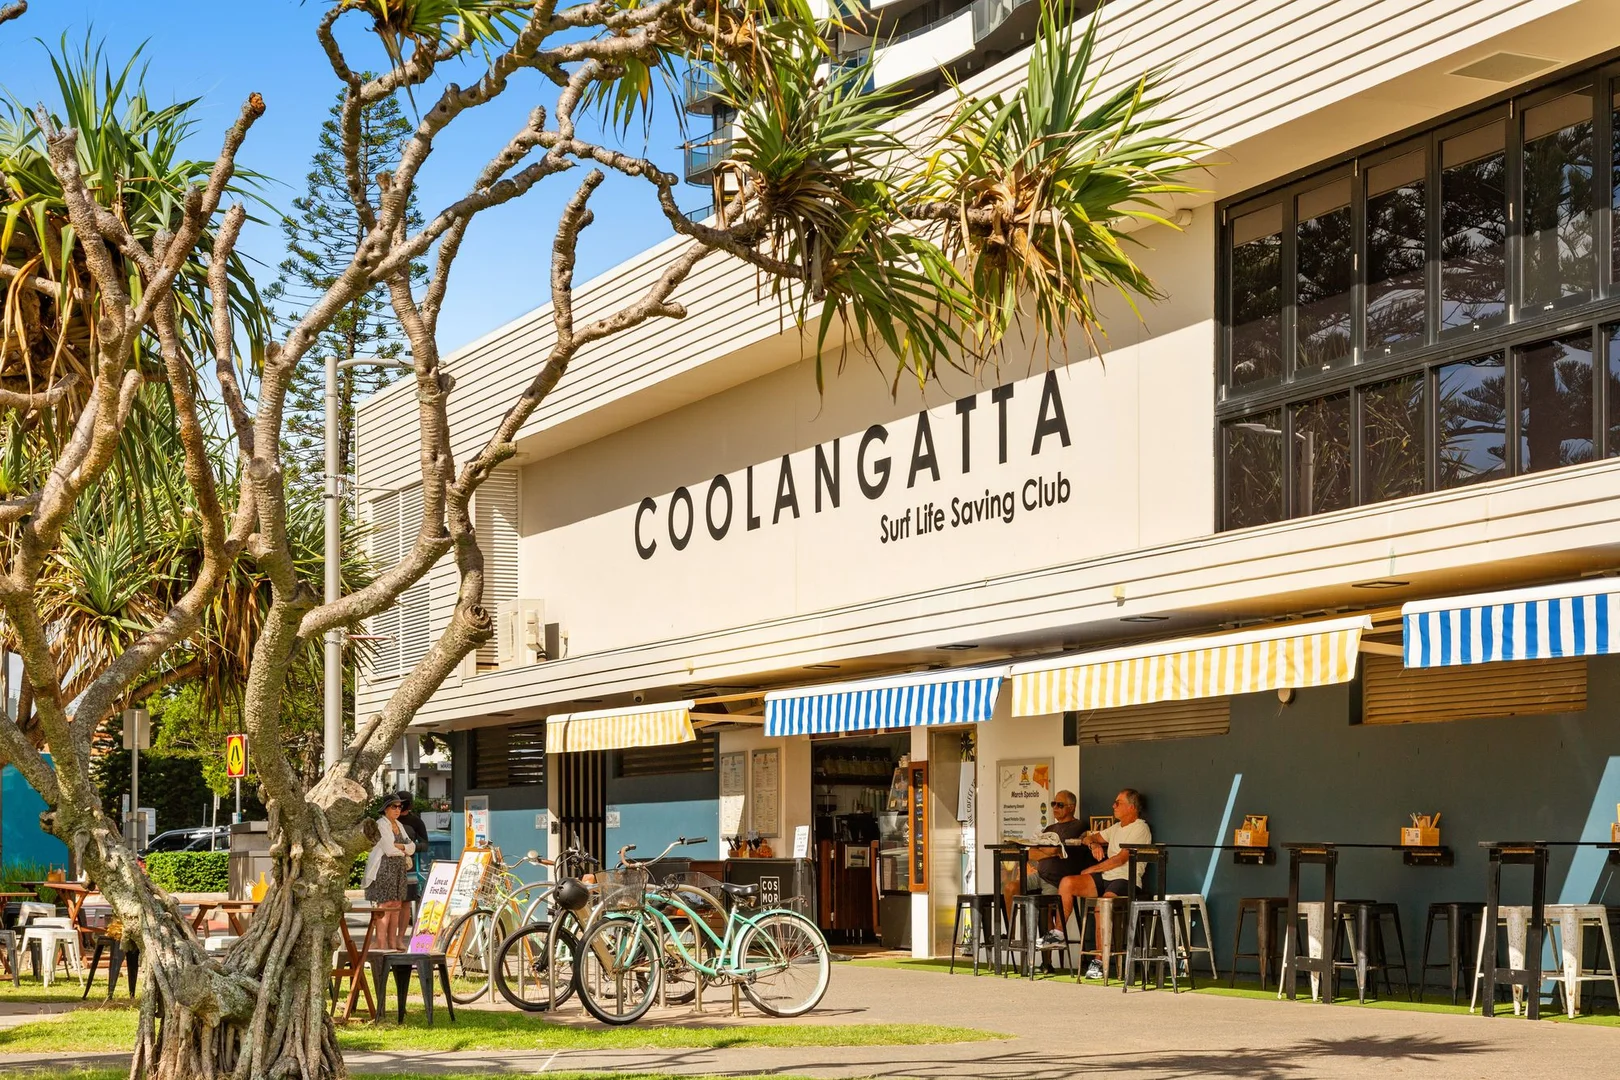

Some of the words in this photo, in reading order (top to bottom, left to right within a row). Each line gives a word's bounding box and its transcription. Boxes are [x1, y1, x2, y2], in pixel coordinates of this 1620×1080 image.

[634, 370, 1071, 560] COOLANGATTA
[880, 508, 912, 543] Surf
[916, 503, 945, 536] Life
[950, 489, 1015, 528] Saving
[1022, 471, 1071, 511] Club
[1011, 790, 1023, 798] March
[1023, 790, 1039, 799] Specials
[966, 787, 974, 813] COFFEE
[433, 877, 443, 885] Love
[762, 880, 778, 891] COS
[429, 886, 440, 894] First
[439, 886, 448, 895] Bite
[762, 893, 779, 903] MOR
